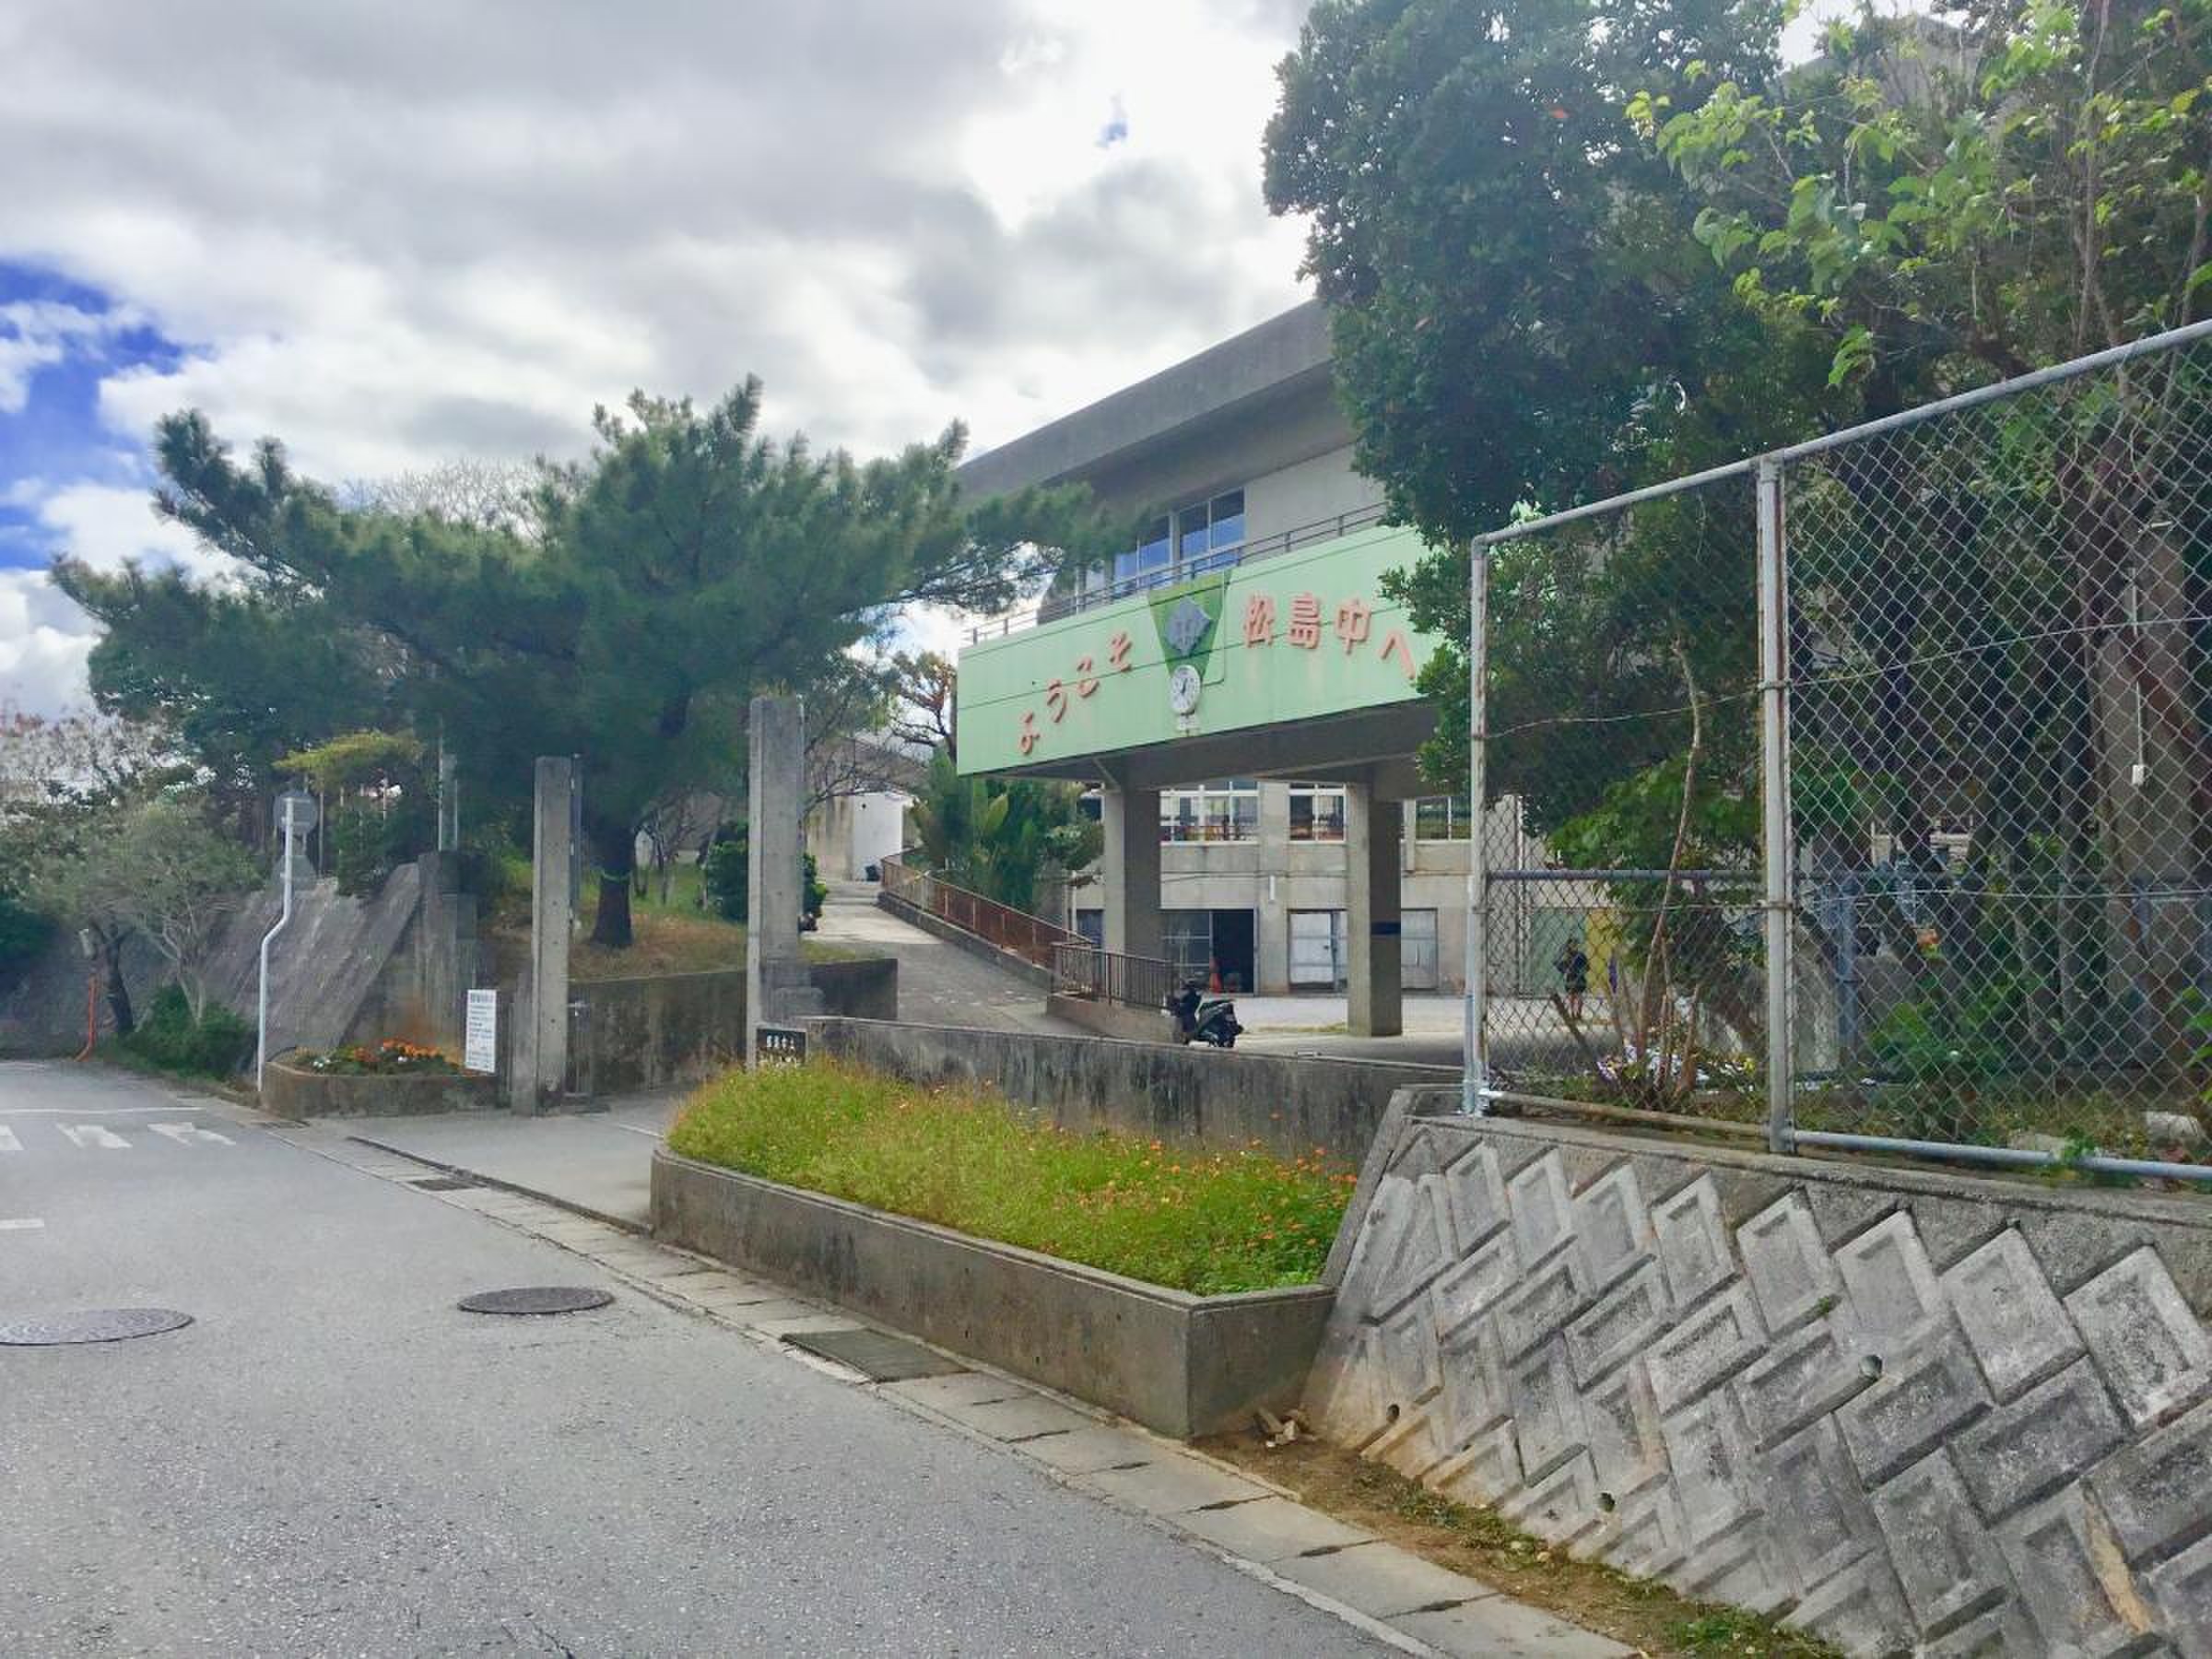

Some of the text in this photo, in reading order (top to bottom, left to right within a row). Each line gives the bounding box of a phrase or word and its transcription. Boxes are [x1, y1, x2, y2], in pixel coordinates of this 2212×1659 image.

[1018, 630, 1132, 755] ようこそ
[1243, 591, 1417, 679] 松島中へ
